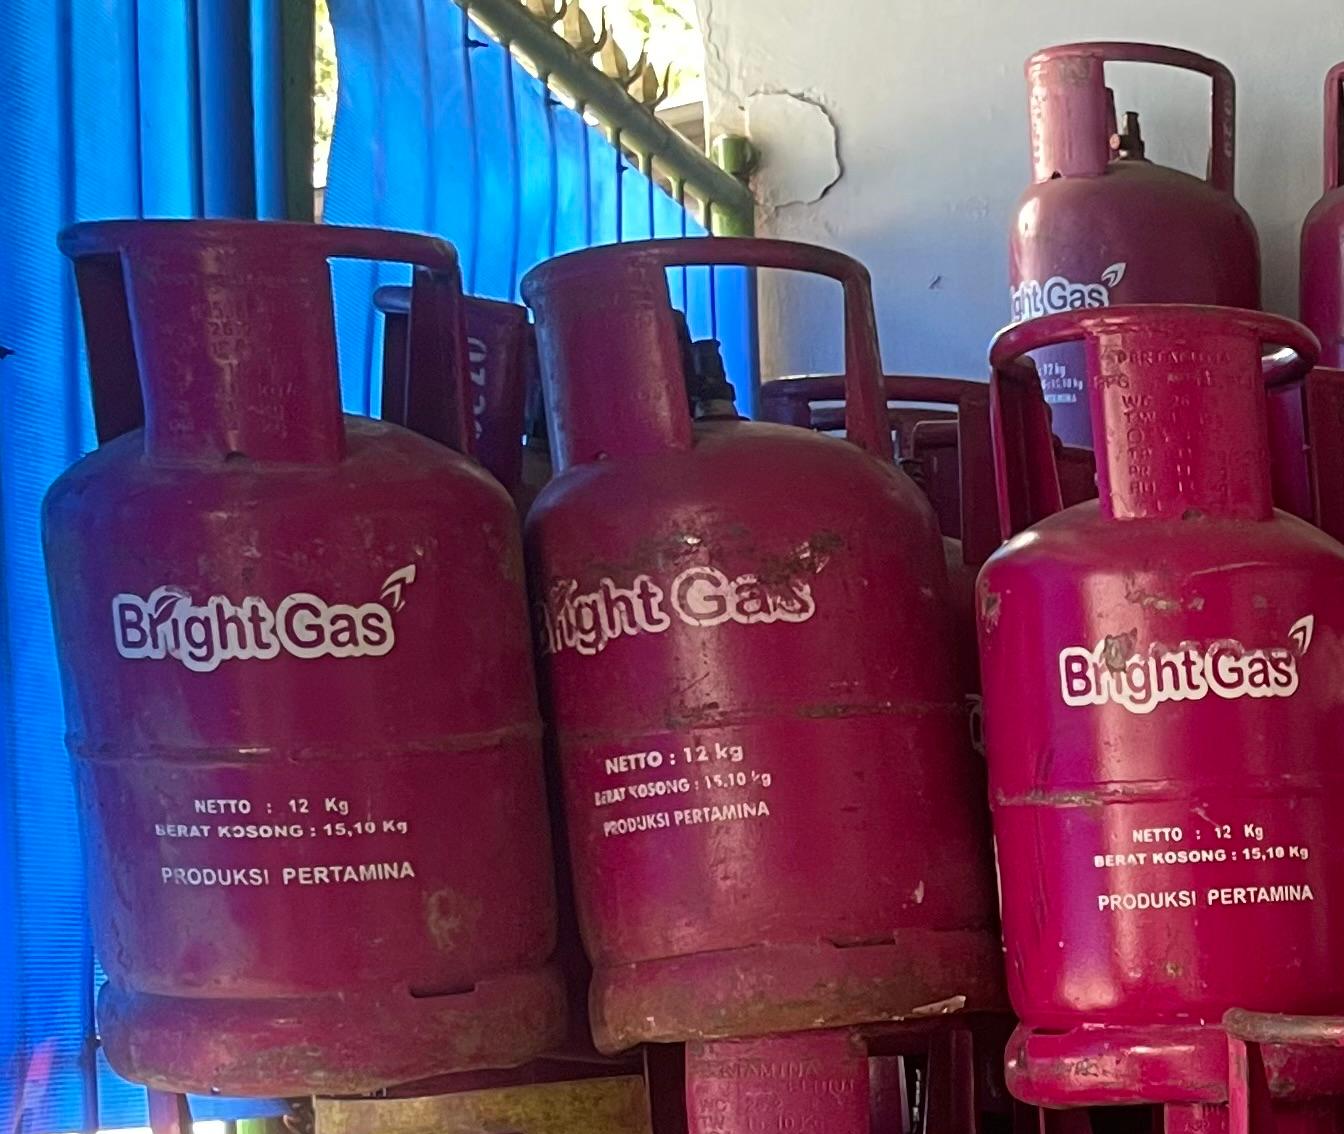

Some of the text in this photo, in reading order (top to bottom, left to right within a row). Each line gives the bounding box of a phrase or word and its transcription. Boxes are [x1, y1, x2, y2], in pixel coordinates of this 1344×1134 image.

[1046, 280, 1106, 311] Gas
[675, 569, 814, 623] Gas
[116, 590, 391, 665] Bright Gas
[1062, 645, 1204, 708] Bright
[1208, 644, 1296, 692] Gas
[604, 750, 663, 775] NETTO
[683, 745, 709, 763] 12
[714, 742, 744, 762] kg
[628, 777, 691, 799] KOSONG
[194, 799, 251, 814] NETTO
[288, 798, 310, 814] 12
[324, 796, 350, 815] Kg
[602, 800, 771, 837] PRODUKSI PERTAMINA
[154, 823, 211, 838] BERAT
[217, 824, 304, 838] KOSONG
[322, 821, 377, 838] 15,10
[382, 819, 409, 834] Kg
[1132, 827, 1183, 843] NETTO
[1214, 824, 1232, 840] 12
[1243, 823, 1264, 841] Kg
[1093, 852, 1147, 868] BERAT
[1152, 848, 1227, 865] KOSONG
[1289, 845, 1309, 860] Kg
[160, 861, 416, 886] PRODUKSI PERTAMINA
[1097, 884, 1314, 912] PRODUKSI PERTAMINA
